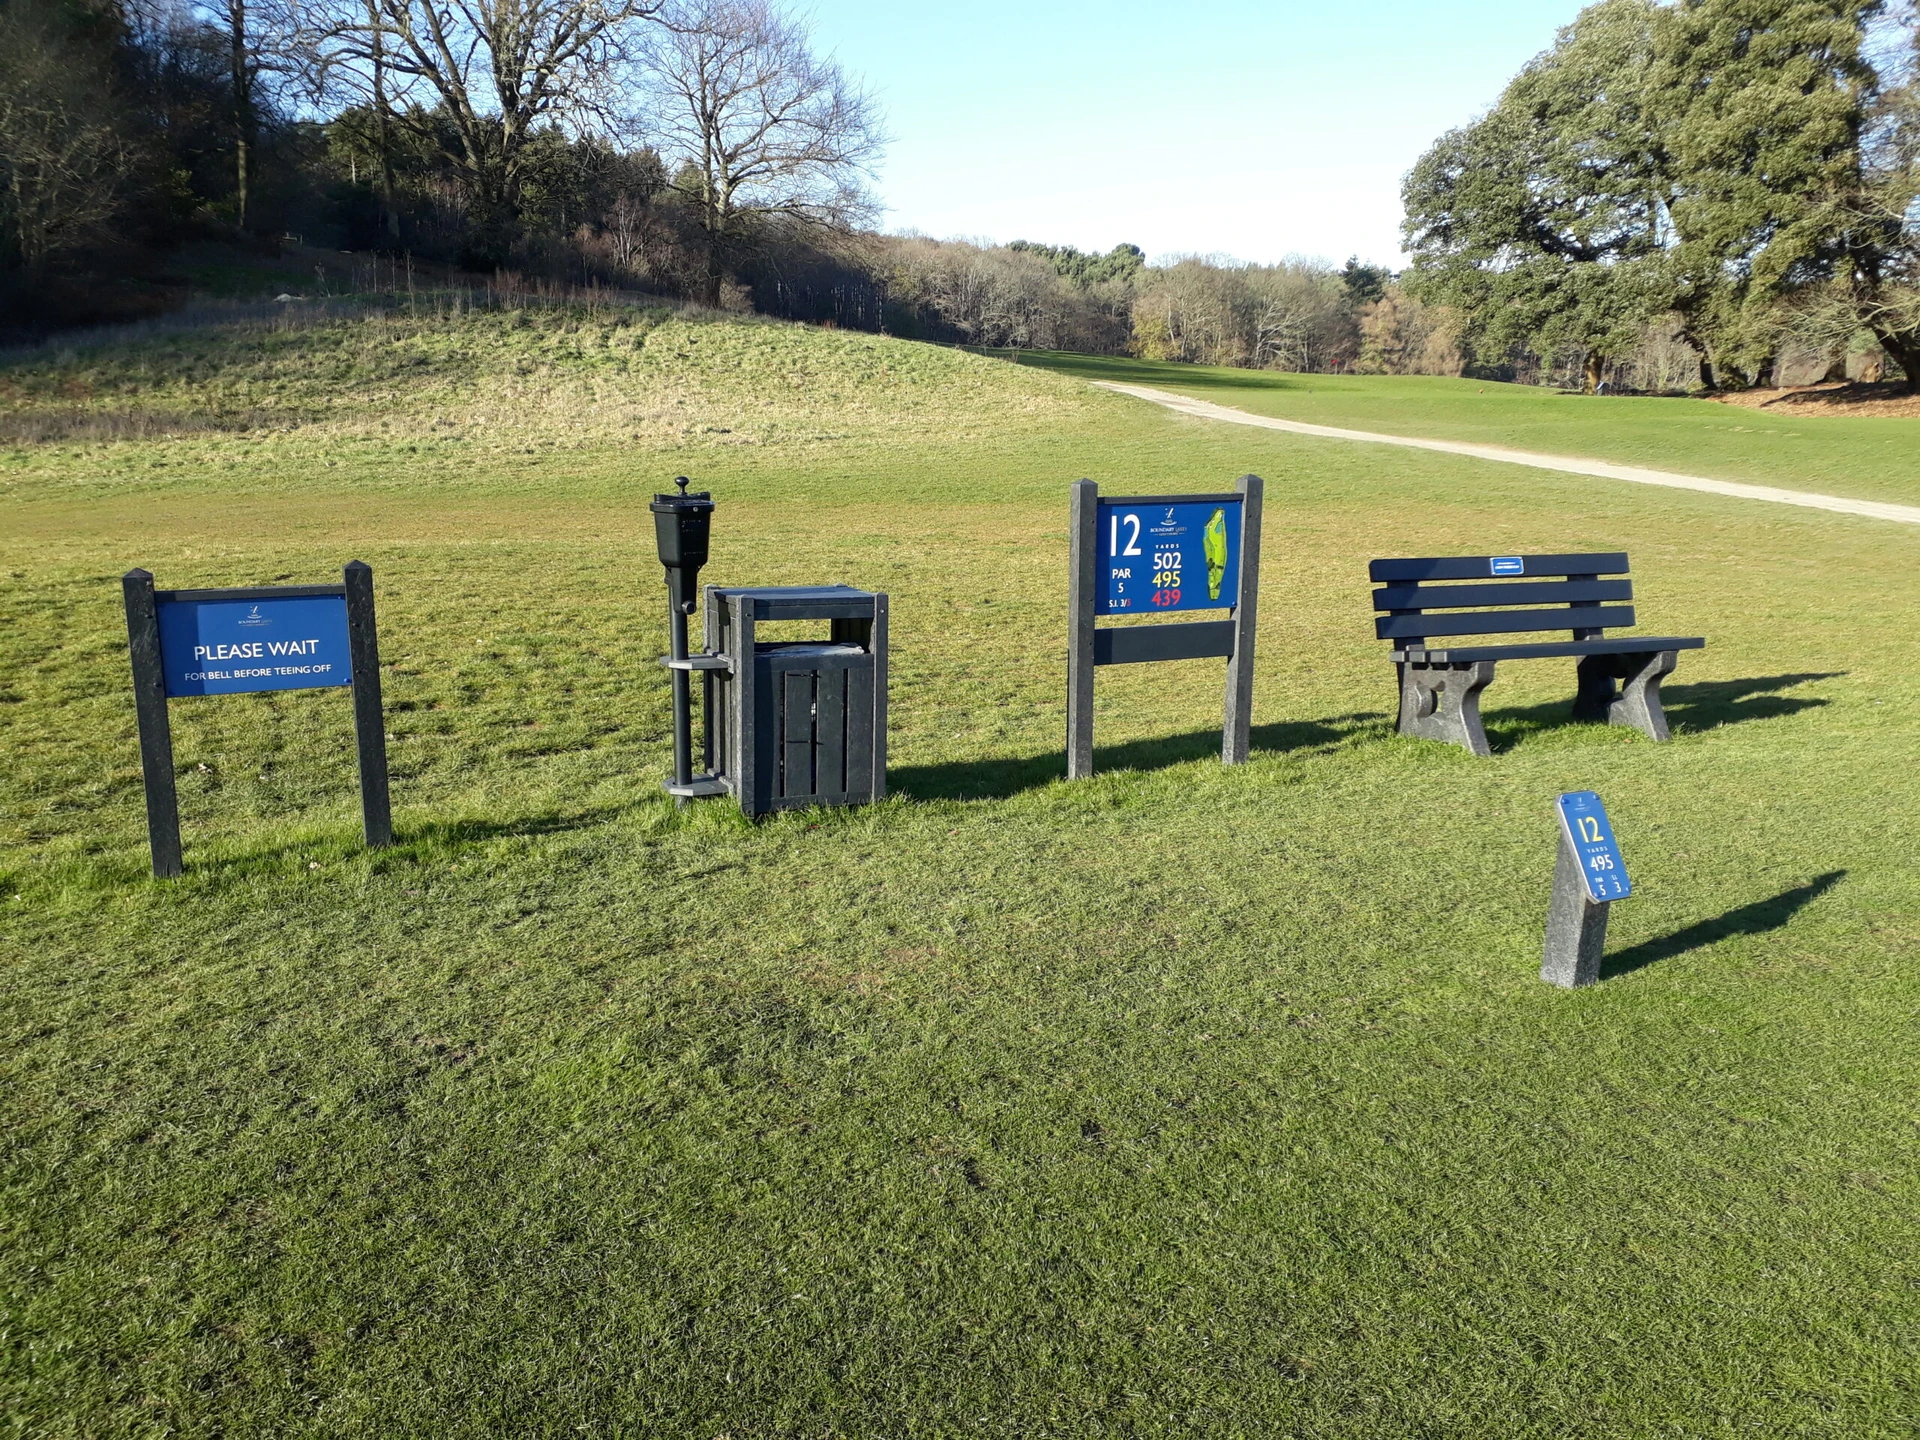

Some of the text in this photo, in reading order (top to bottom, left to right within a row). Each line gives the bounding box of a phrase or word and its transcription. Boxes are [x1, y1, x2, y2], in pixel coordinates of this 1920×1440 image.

[1110, 514, 1142, 557] 12
[1153, 552, 1182, 570] 502
[1112, 568, 1131, 579] PAR
[1152, 571, 1181, 588] 495
[1118, 582, 1124, 593] 5
[1151, 589, 1181, 607] 439
[194, 640, 319, 661] PLEASE WAIT
[185, 664, 332, 681] FOR BELL BEFORE TEEING OFF
[1577, 816, 1605, 843] 12
[1587, 846, 1608, 854] YARDS
[1590, 854, 1614, 872] 495
[1599, 884, 1606, 896] 5
[1614, 882, 1622, 893] 3
